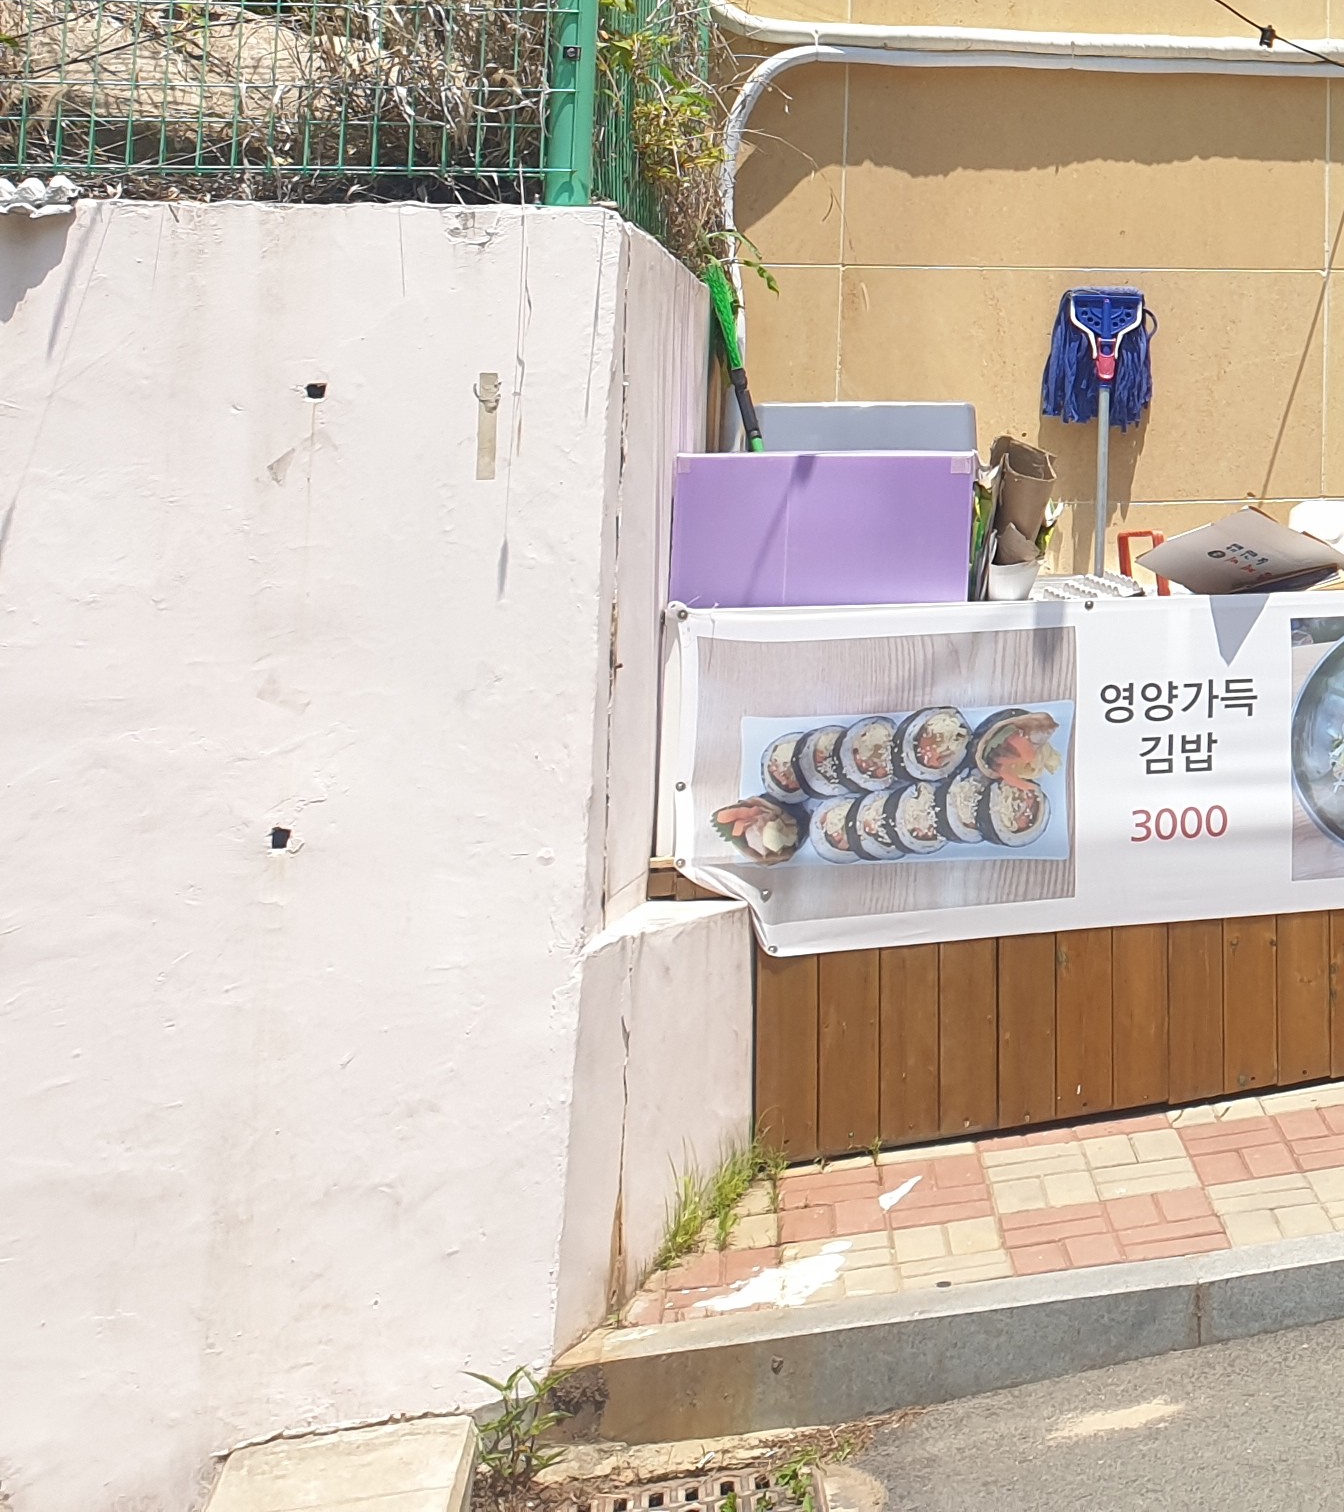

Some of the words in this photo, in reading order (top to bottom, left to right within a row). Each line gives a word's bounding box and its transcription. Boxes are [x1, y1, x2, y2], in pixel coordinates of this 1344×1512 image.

[1100, 678, 1258, 724] 영양가득
[1138, 731, 1218, 775] 김밥
[1130, 804, 1229, 843] 3000
